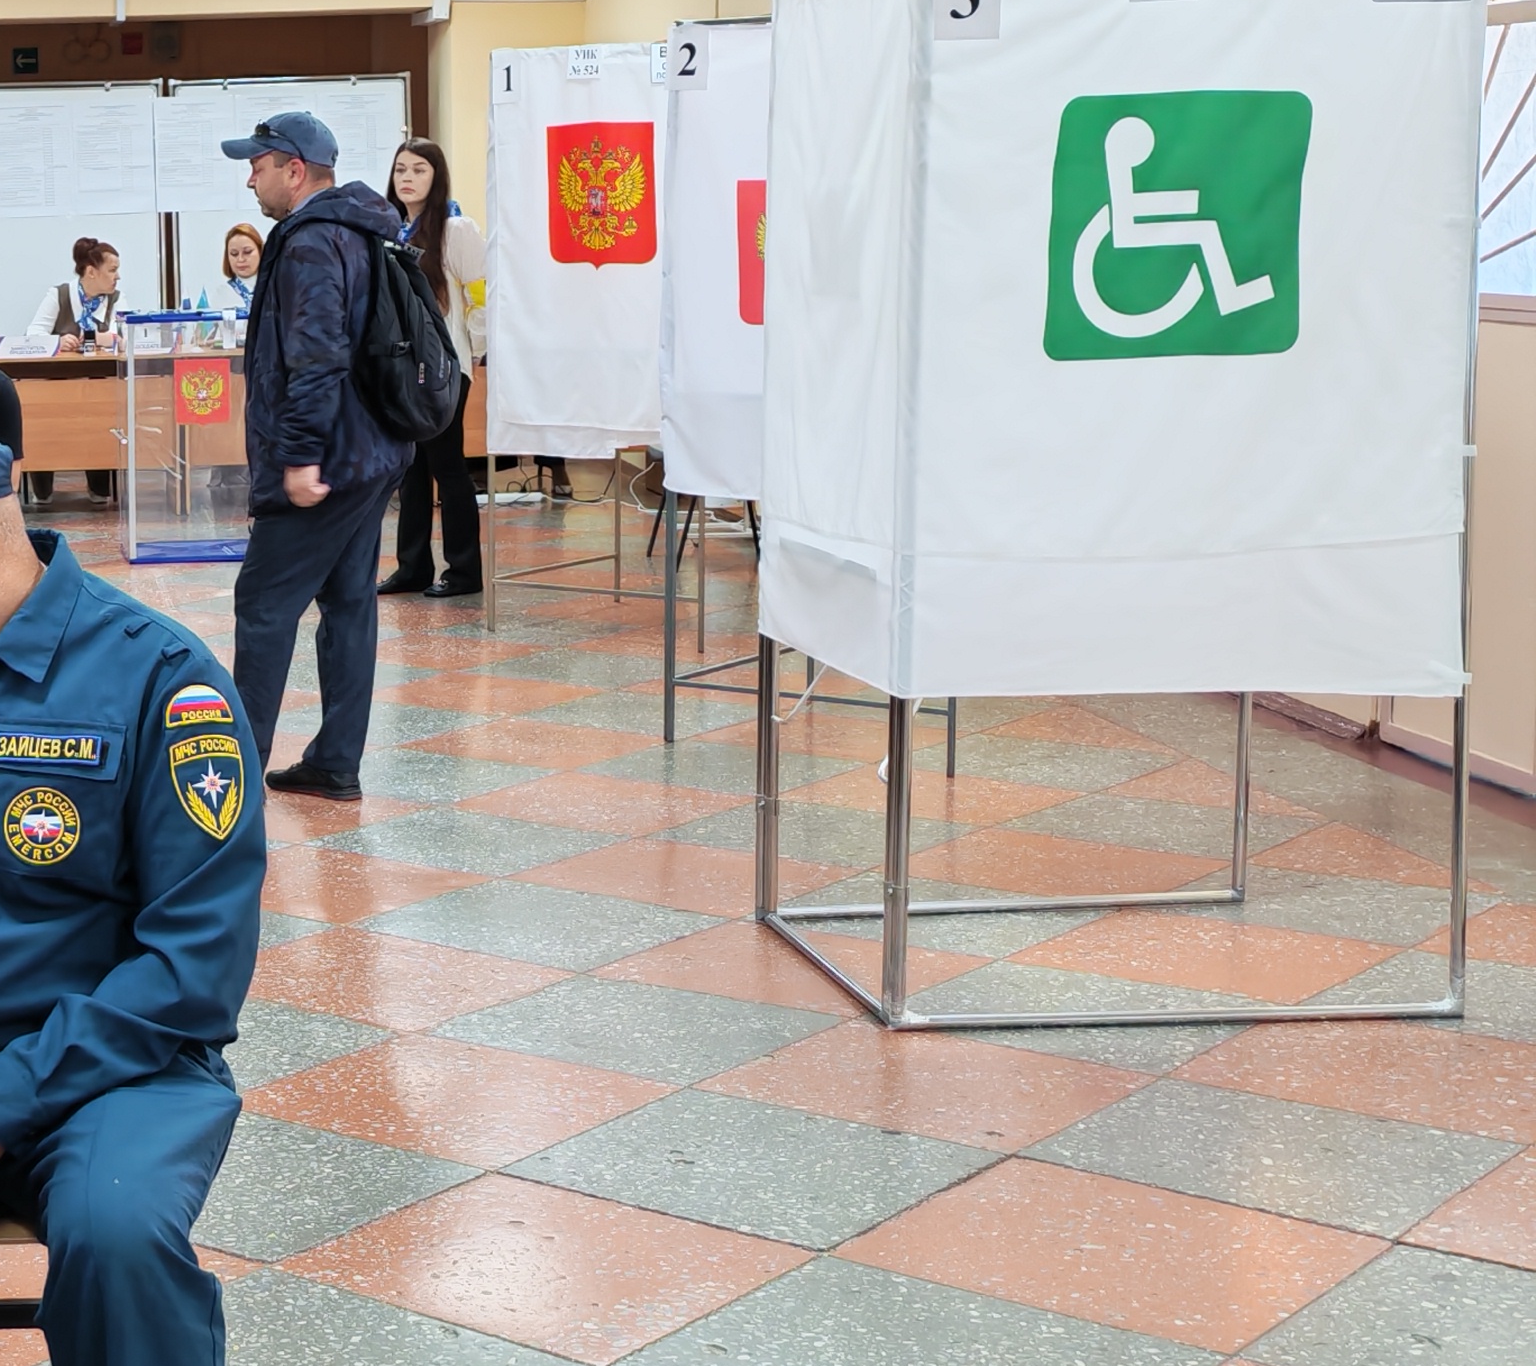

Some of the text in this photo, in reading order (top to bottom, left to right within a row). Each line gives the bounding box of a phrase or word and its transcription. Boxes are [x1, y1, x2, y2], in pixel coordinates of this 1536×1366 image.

[574, 49, 597, 60] УИК
[677, 42, 697, 76] 2
[503, 64, 513, 92] 1
[583, 66, 599, 75] 524
[181, 709, 222, 721] РОССИЯ
[174, 738, 236, 761] МЧС РОССИИ
[11, 791, 76, 827] МЧС РОССИИ
[9, 823, 75, 860] EMERCOM
